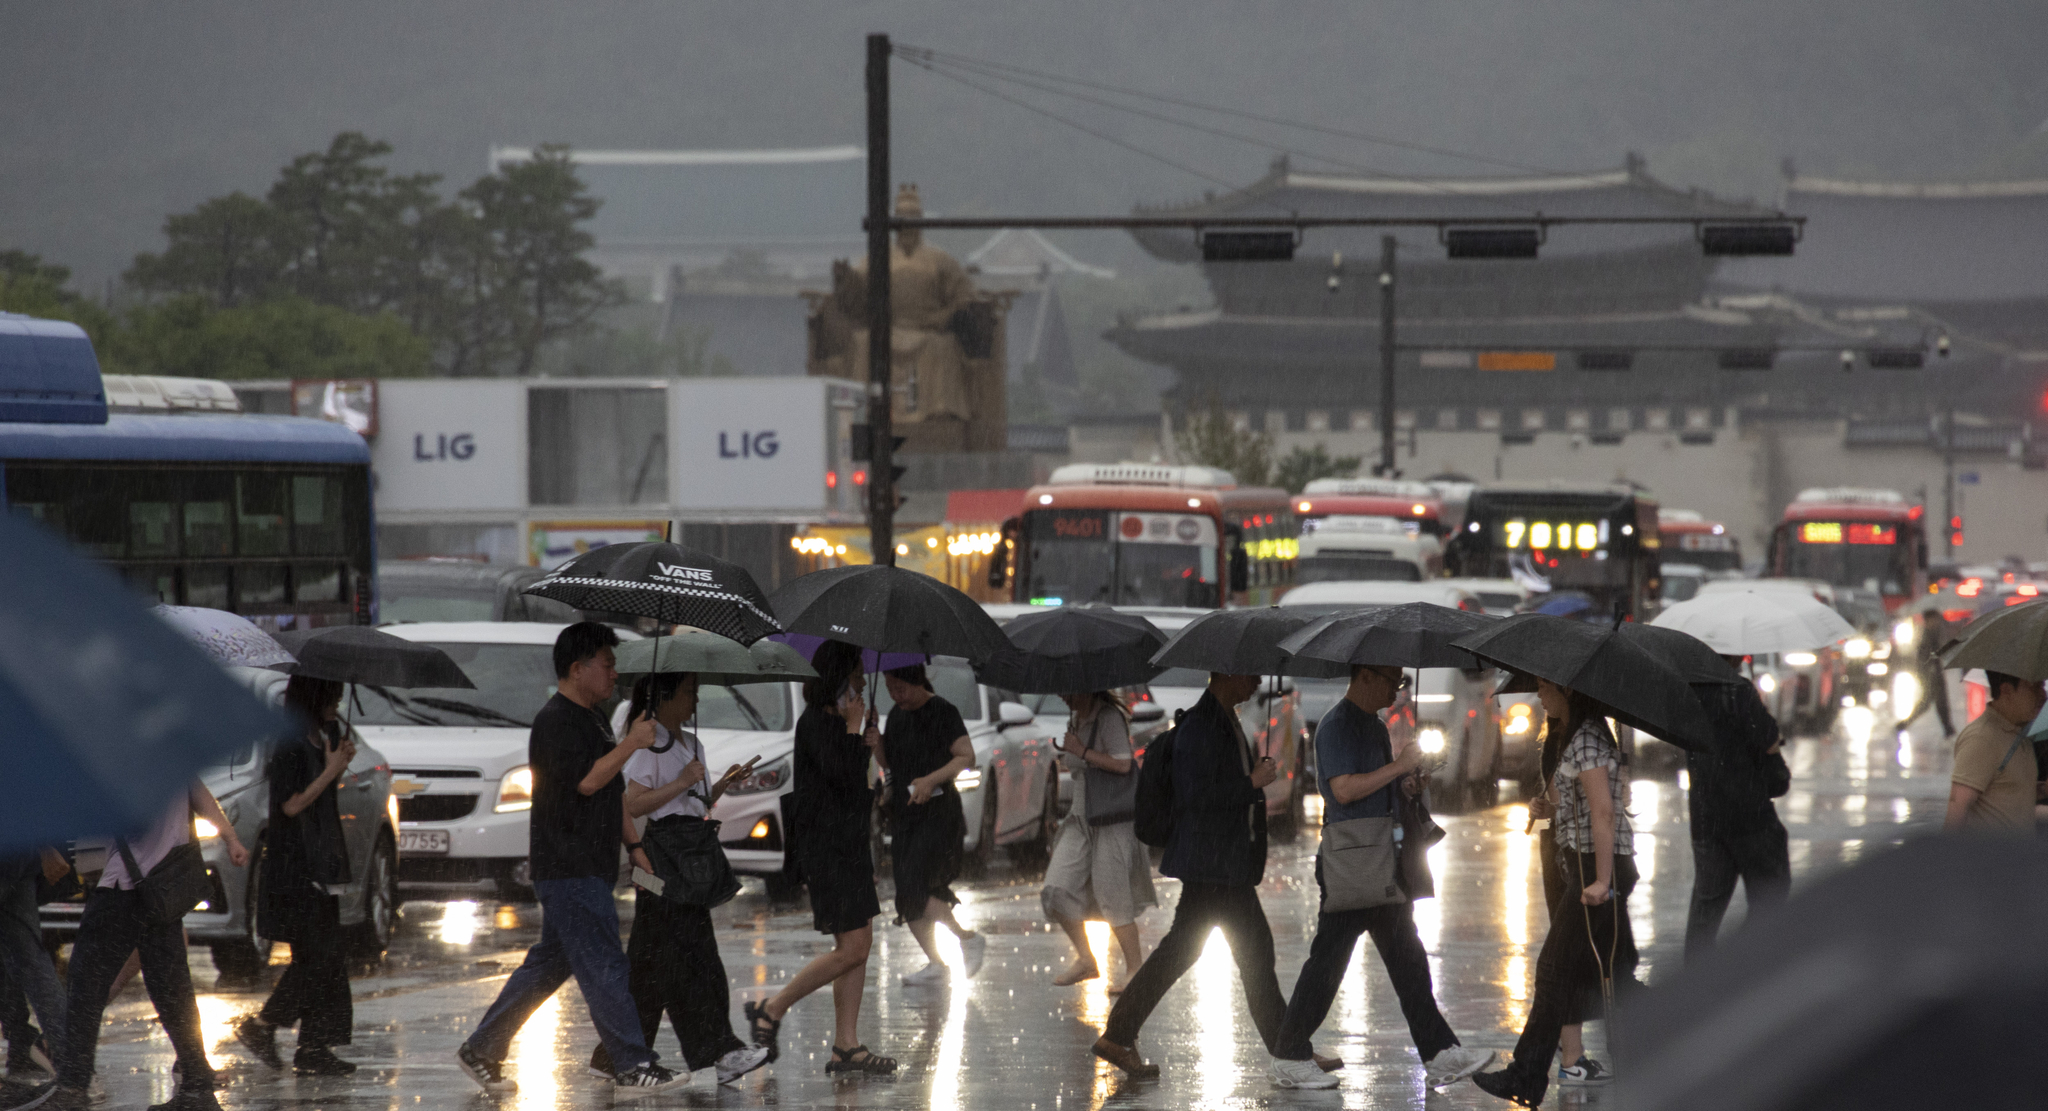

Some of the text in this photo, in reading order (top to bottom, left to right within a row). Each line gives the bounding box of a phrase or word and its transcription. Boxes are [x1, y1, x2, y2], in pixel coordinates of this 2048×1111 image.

[414, 431, 478, 461] LIG
[718, 431, 779, 459] LIG
[657, 561, 713, 581] VANS
[399, 832, 440, 849] 0755
